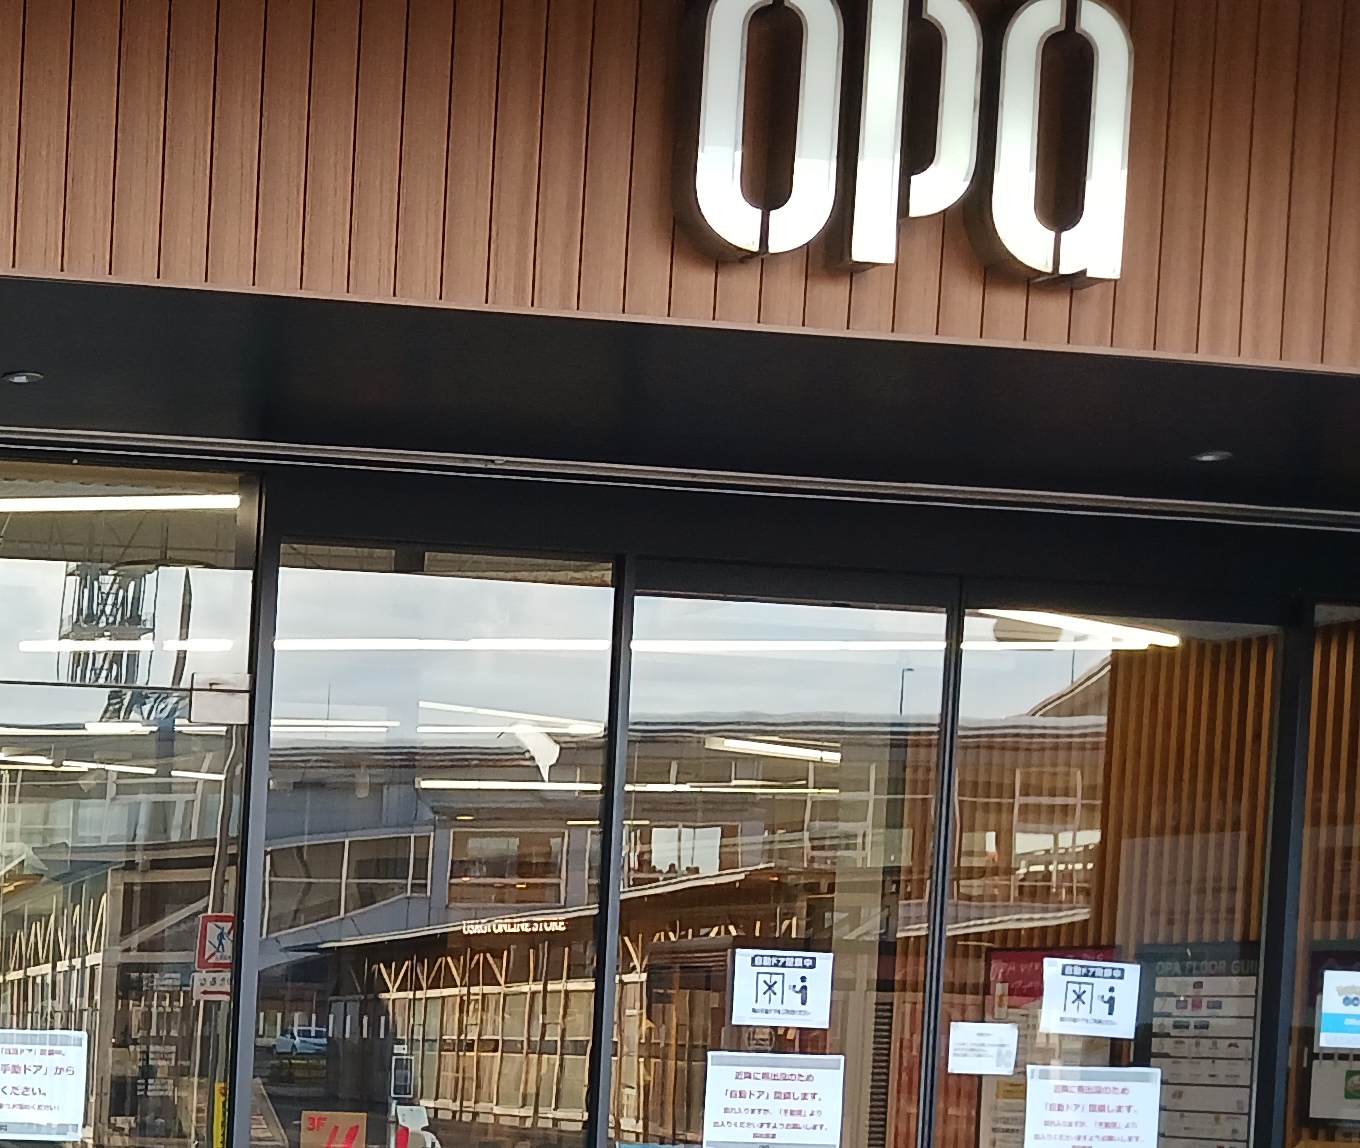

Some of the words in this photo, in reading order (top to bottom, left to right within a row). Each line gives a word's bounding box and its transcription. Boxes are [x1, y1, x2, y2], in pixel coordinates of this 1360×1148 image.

[694, 0, 1134, 280] opa
[1185, 960, 1227, 975] FLOOR
[306, 1116, 327, 1132] 3F
